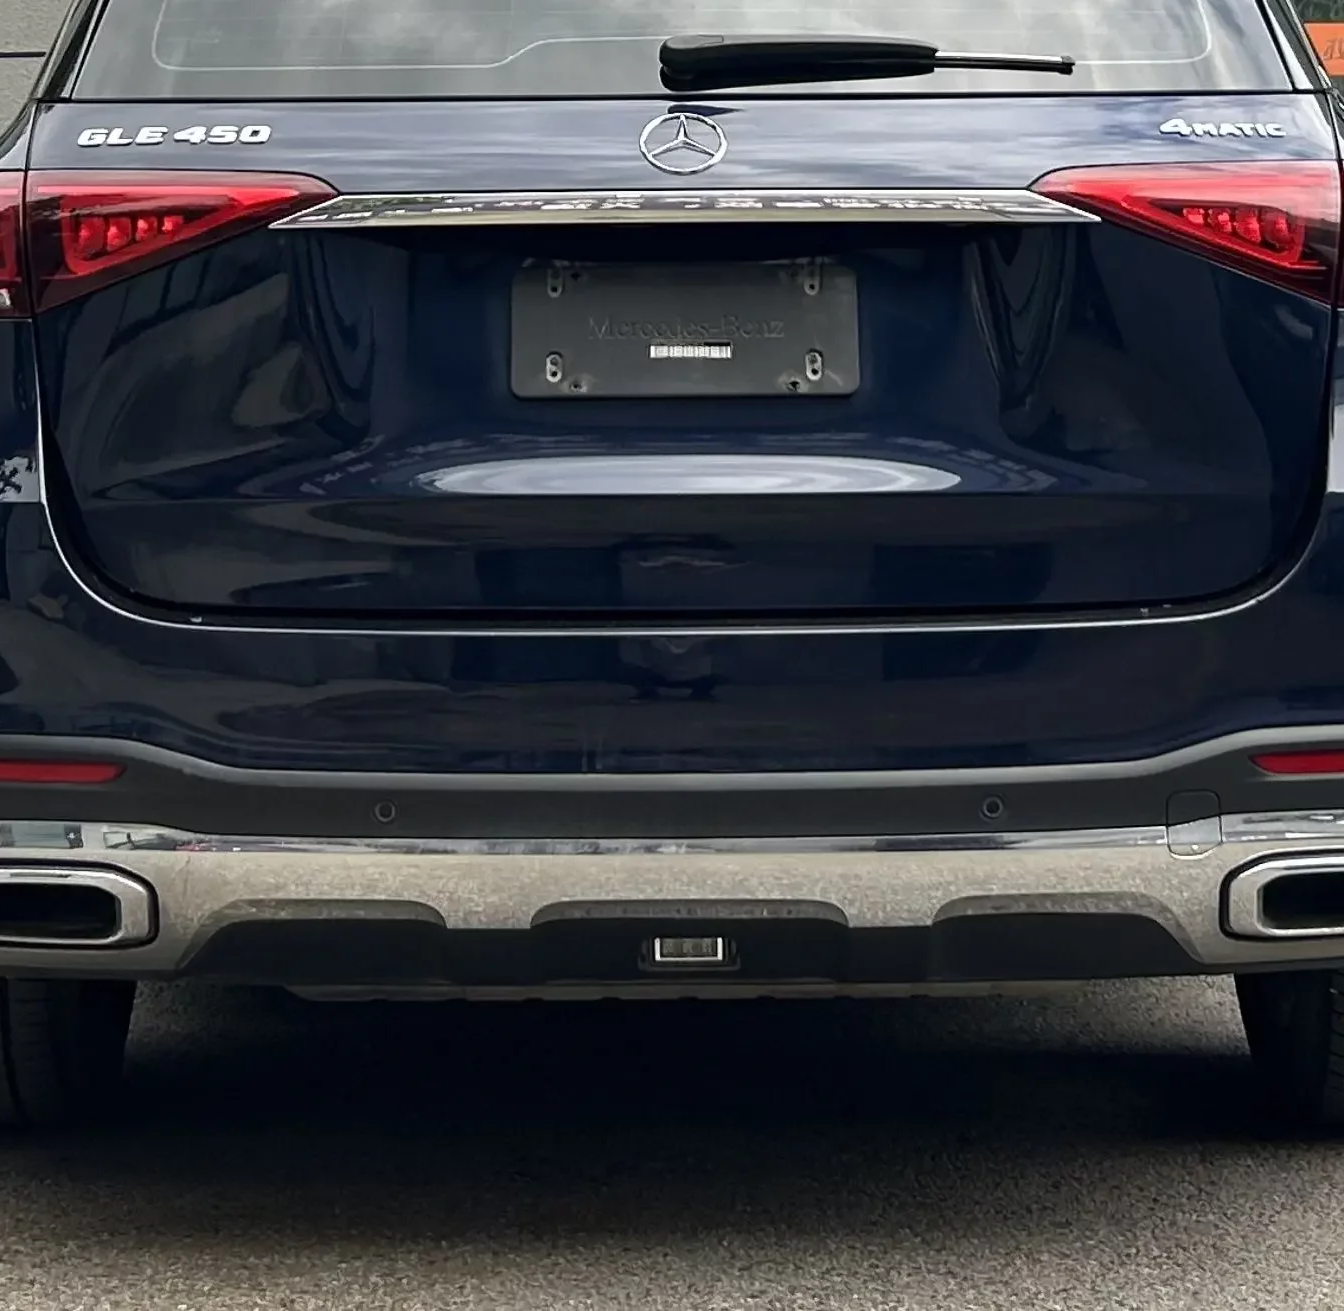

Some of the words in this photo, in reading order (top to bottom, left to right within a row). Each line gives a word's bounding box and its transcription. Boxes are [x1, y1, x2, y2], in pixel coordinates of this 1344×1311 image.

[77, 127, 169, 147] GLE
[173, 125, 272, 144] 450
[1159, 118, 1287, 137] 4MATIC
[588, 315, 785, 339] Mercedes-Benz
